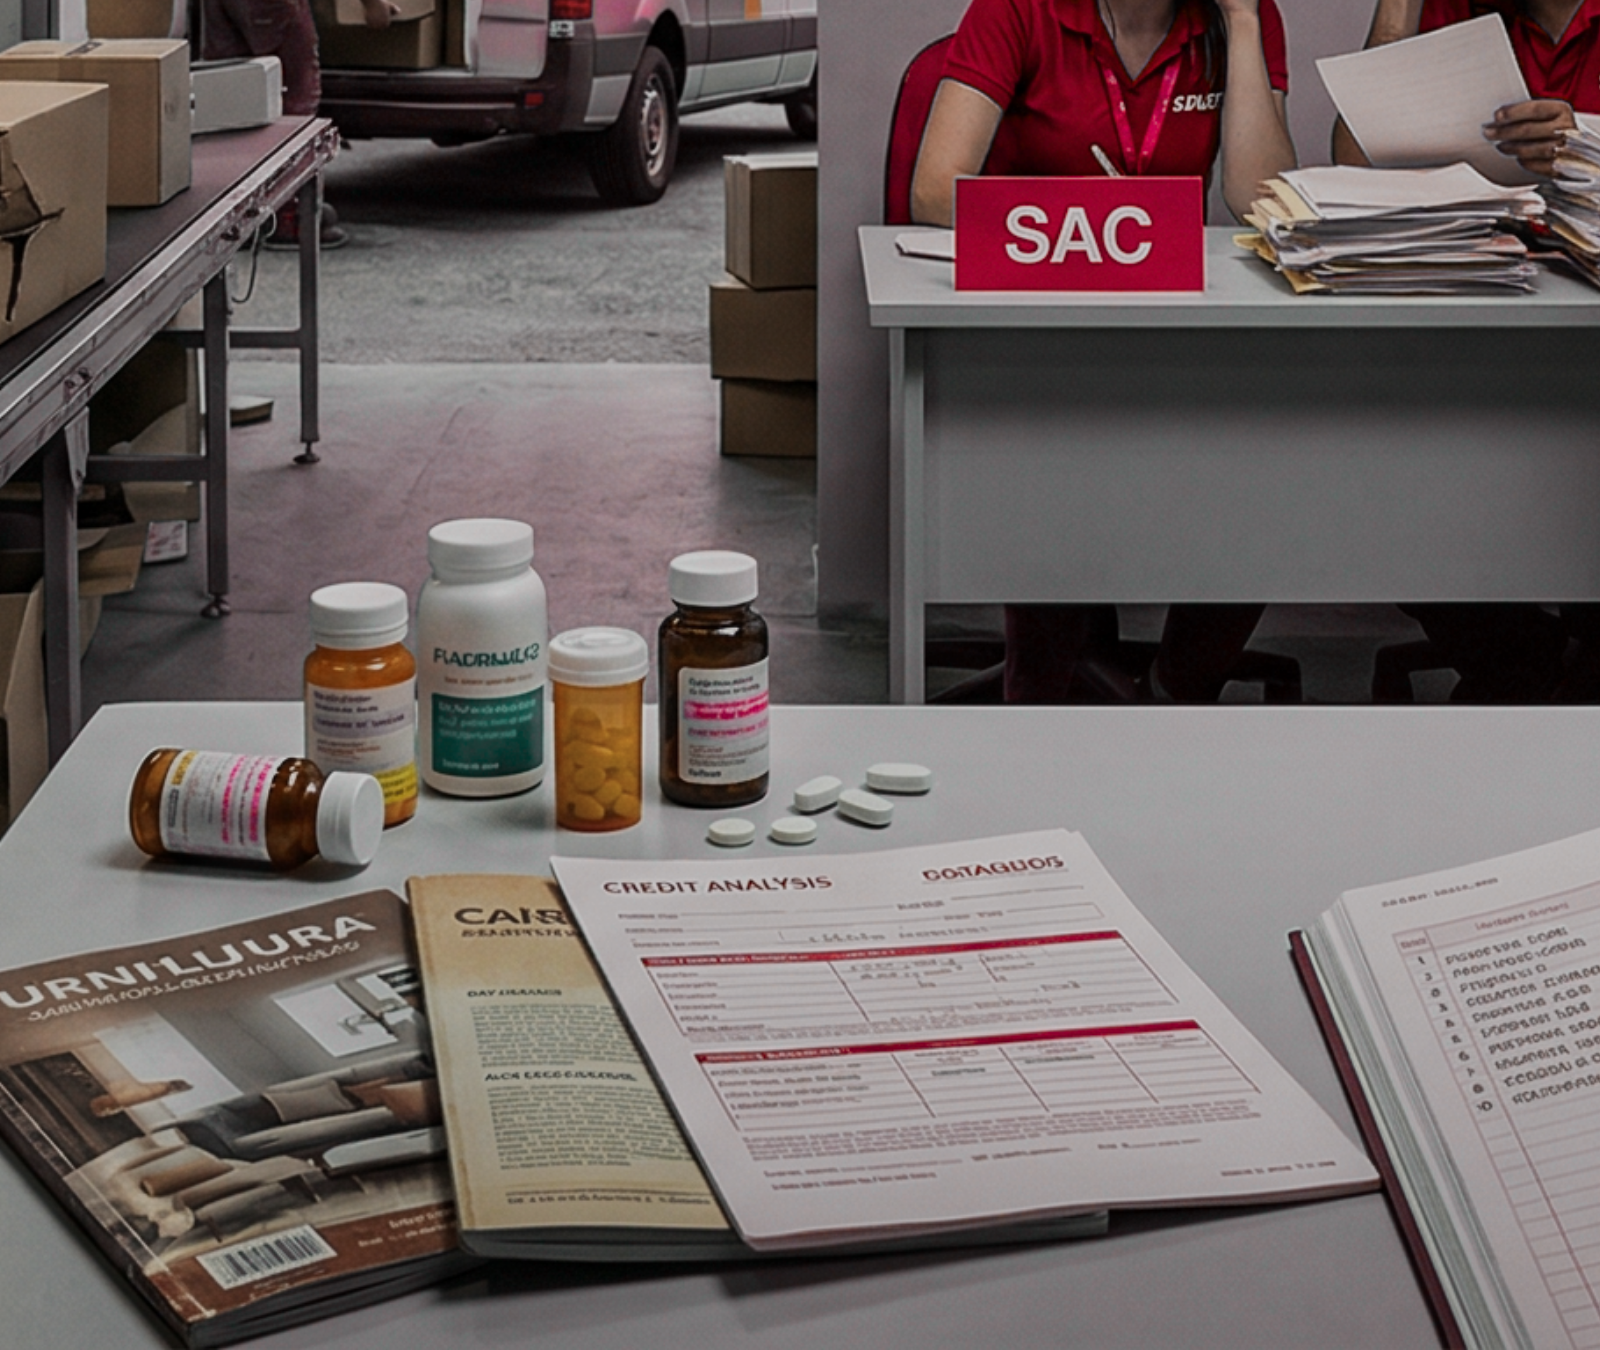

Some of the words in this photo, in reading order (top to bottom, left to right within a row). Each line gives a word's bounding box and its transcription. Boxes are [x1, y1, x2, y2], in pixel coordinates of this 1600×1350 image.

[1004, 204, 1153, 266] SAC
[603, 879, 698, 895] CREDIT
[707, 875, 833, 894] ANALYSIS
